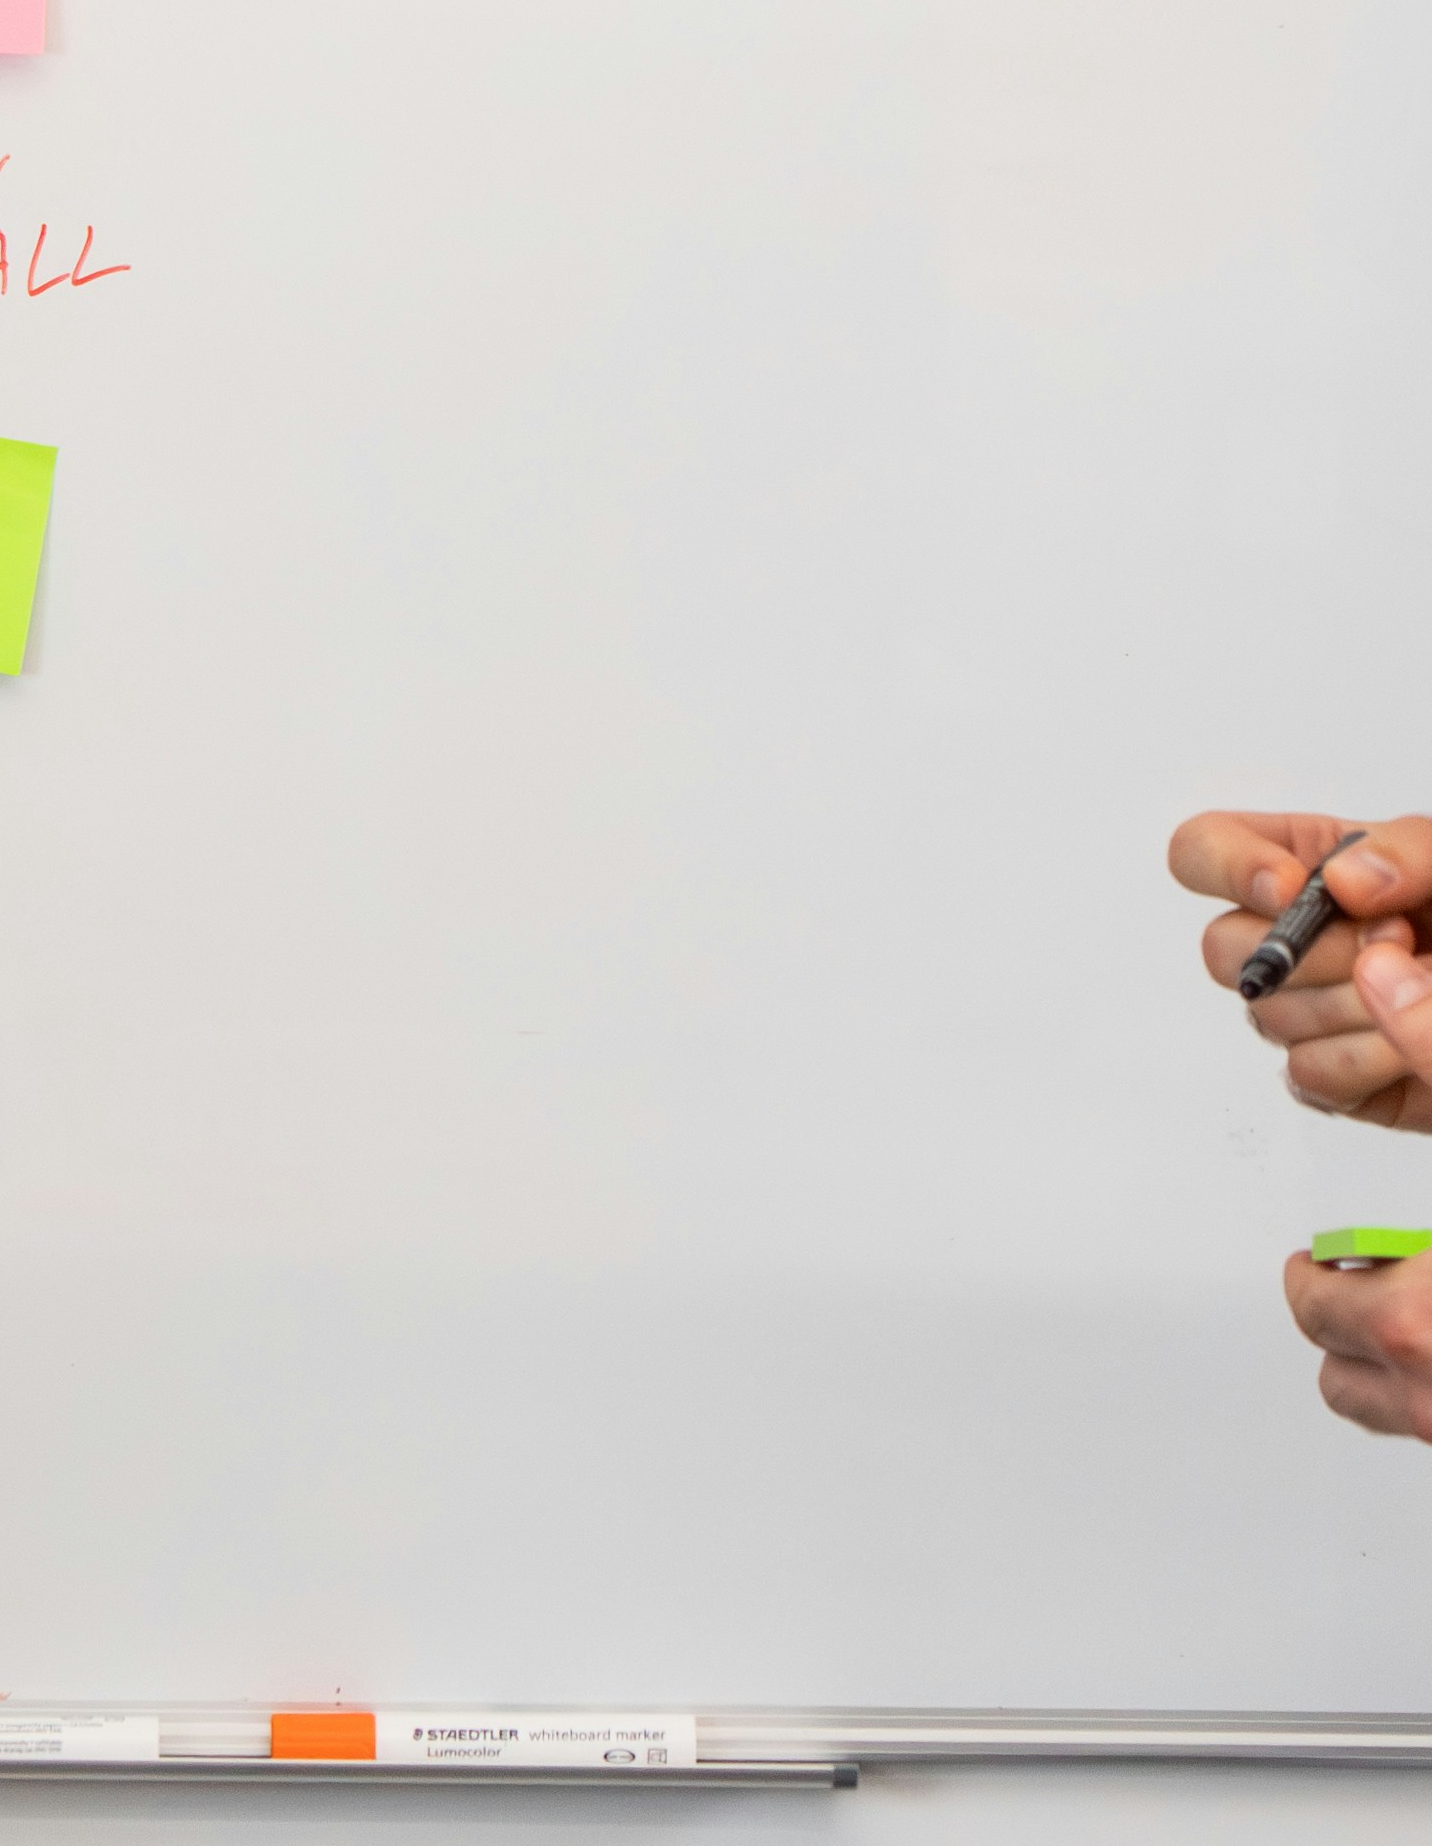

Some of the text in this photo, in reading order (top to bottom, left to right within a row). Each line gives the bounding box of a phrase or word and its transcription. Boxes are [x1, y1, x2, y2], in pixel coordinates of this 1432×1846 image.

[426, 1728, 667, 1742] STAEDTLER whiteboard marker
[426, 1745, 503, 1759] Lumocolor
